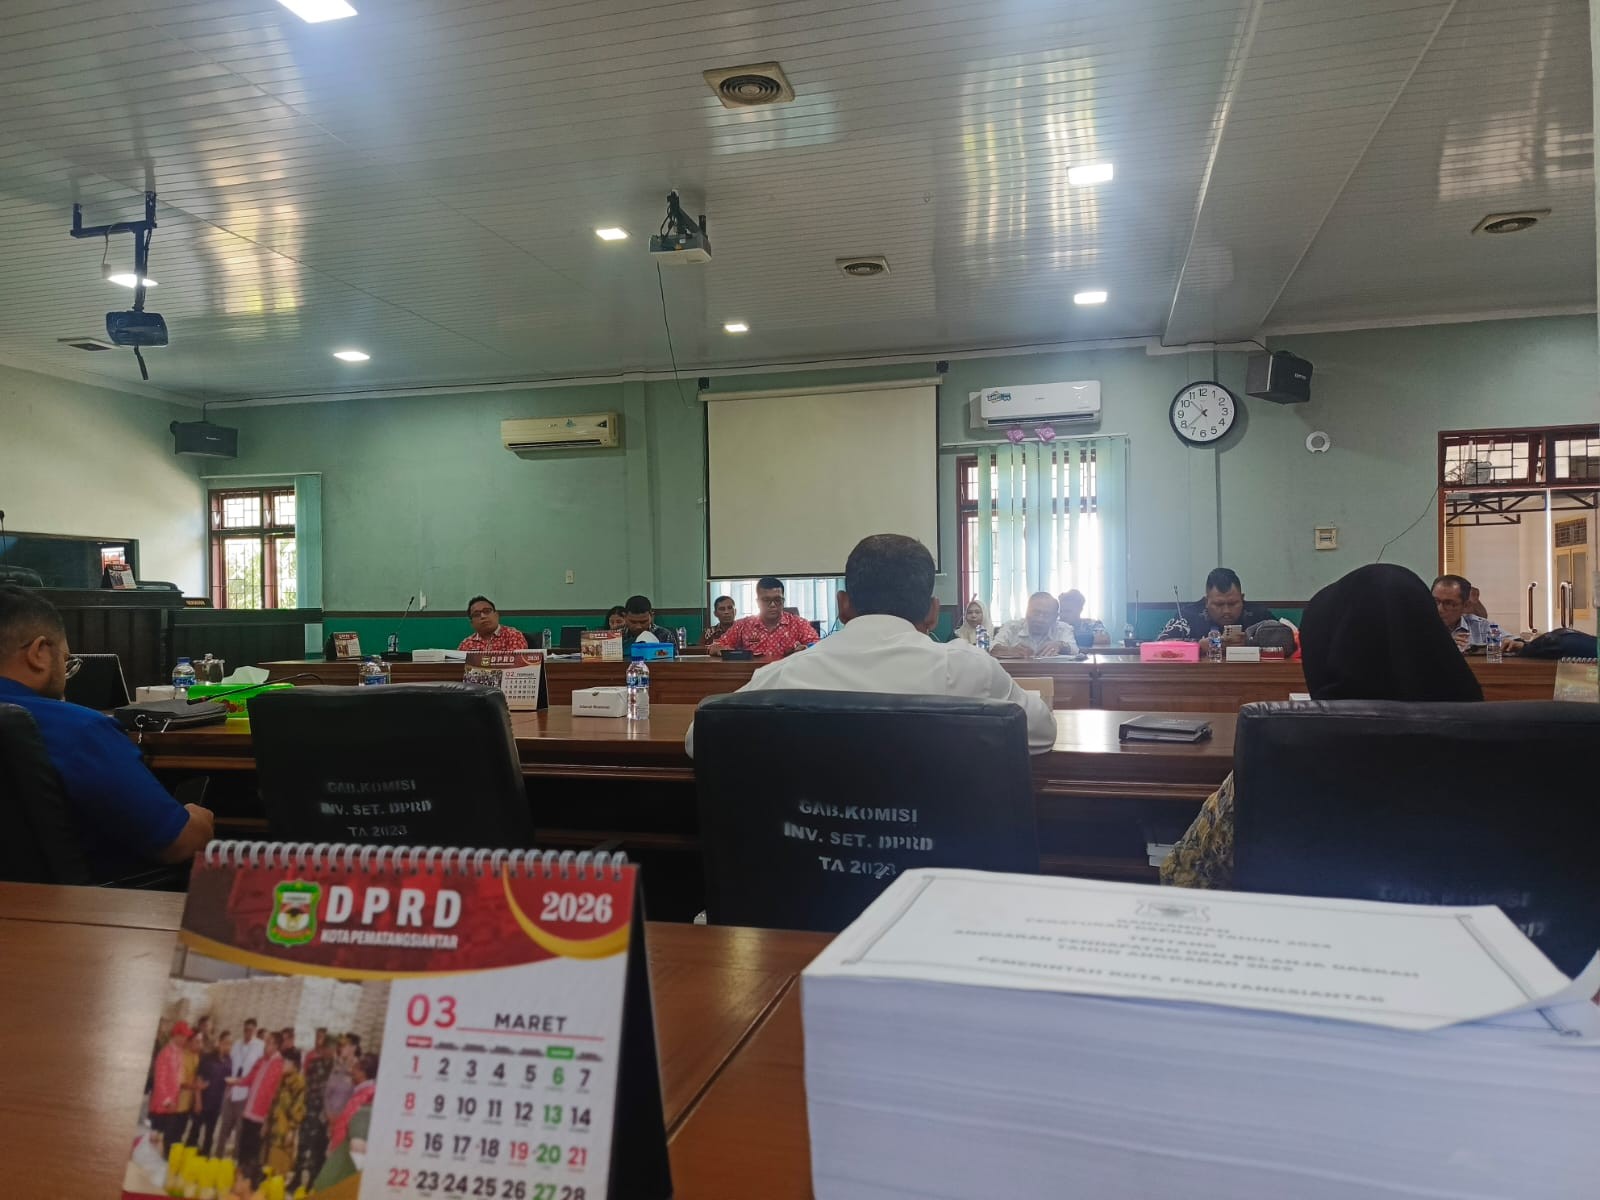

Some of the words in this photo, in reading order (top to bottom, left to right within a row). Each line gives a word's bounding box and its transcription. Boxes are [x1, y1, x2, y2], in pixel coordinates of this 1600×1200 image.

[1189, 392, 1195, 400] 11
[1199, 388, 1207, 396] 12
[1181, 400, 1190, 408] 10
[1218, 397, 1225, 406] 2
[1177, 410, 1184, 418] 9
[1221, 407, 1228, 416] 3
[1180, 420, 1187, 428] 8
[1218, 418, 1225, 426] 4
[1191, 426, 1196, 436] 7
[1211, 426, 1217, 434] 5
[352, 804, 385, 815] SET.
[389, 800, 432, 813] DPRD
[799, 800, 918, 823] GAB.KOMISI
[347, 826, 368, 837] TA
[784, 821, 823, 843] INV.
[829, 832, 872, 848] SET.
[879, 835, 934, 851] DPRD
[818, 856, 845, 872] TA
[326, 885, 461, 928] DPRD
[540, 891, 613, 924] 2026
[321, 929, 350, 944] KOTA
[407, 993, 457, 1029] 03
[495, 1013, 567, 1032] MARET
[412, 1055, 419, 1073] 1
[438, 1057, 450, 1075] 2
[466, 1059, 477, 1078] 3
[493, 1062, 505, 1080] 4
[525, 1064, 536, 1082] 5
[552, 1066, 564, 1085] 6
[580, 1068, 591, 1087] 7
[404, 1092, 416, 1111] 8
[434, 1094, 445, 1113] 9
[457, 1096, 477, 1115] 10
[488, 1099, 502, 1118] 11
[515, 1101, 533, 1121] 12
[544, 1104, 562, 1124] 13
[571, 1106, 591, 1126] 14
[395, 1130, 414, 1149] 15
[425, 1132, 443, 1152] 16
[453, 1135, 471, 1154] 17
[481, 1137, 500, 1158] 18
[510, 1140, 529, 1160] 19
[536, 1143, 561, 1164] 20
[568, 1146, 587, 1167] 21
[387, 1167, 410, 1188] 22
[416, 1170, 439, 1191] 23
[443, 1173, 468, 1193] 24
[472, 1176, 497, 1197] 25
[502, 1179, 526, 1200] 26
[533, 1183, 557, 1200] 27
[561, 1186, 586, 1200] 28
